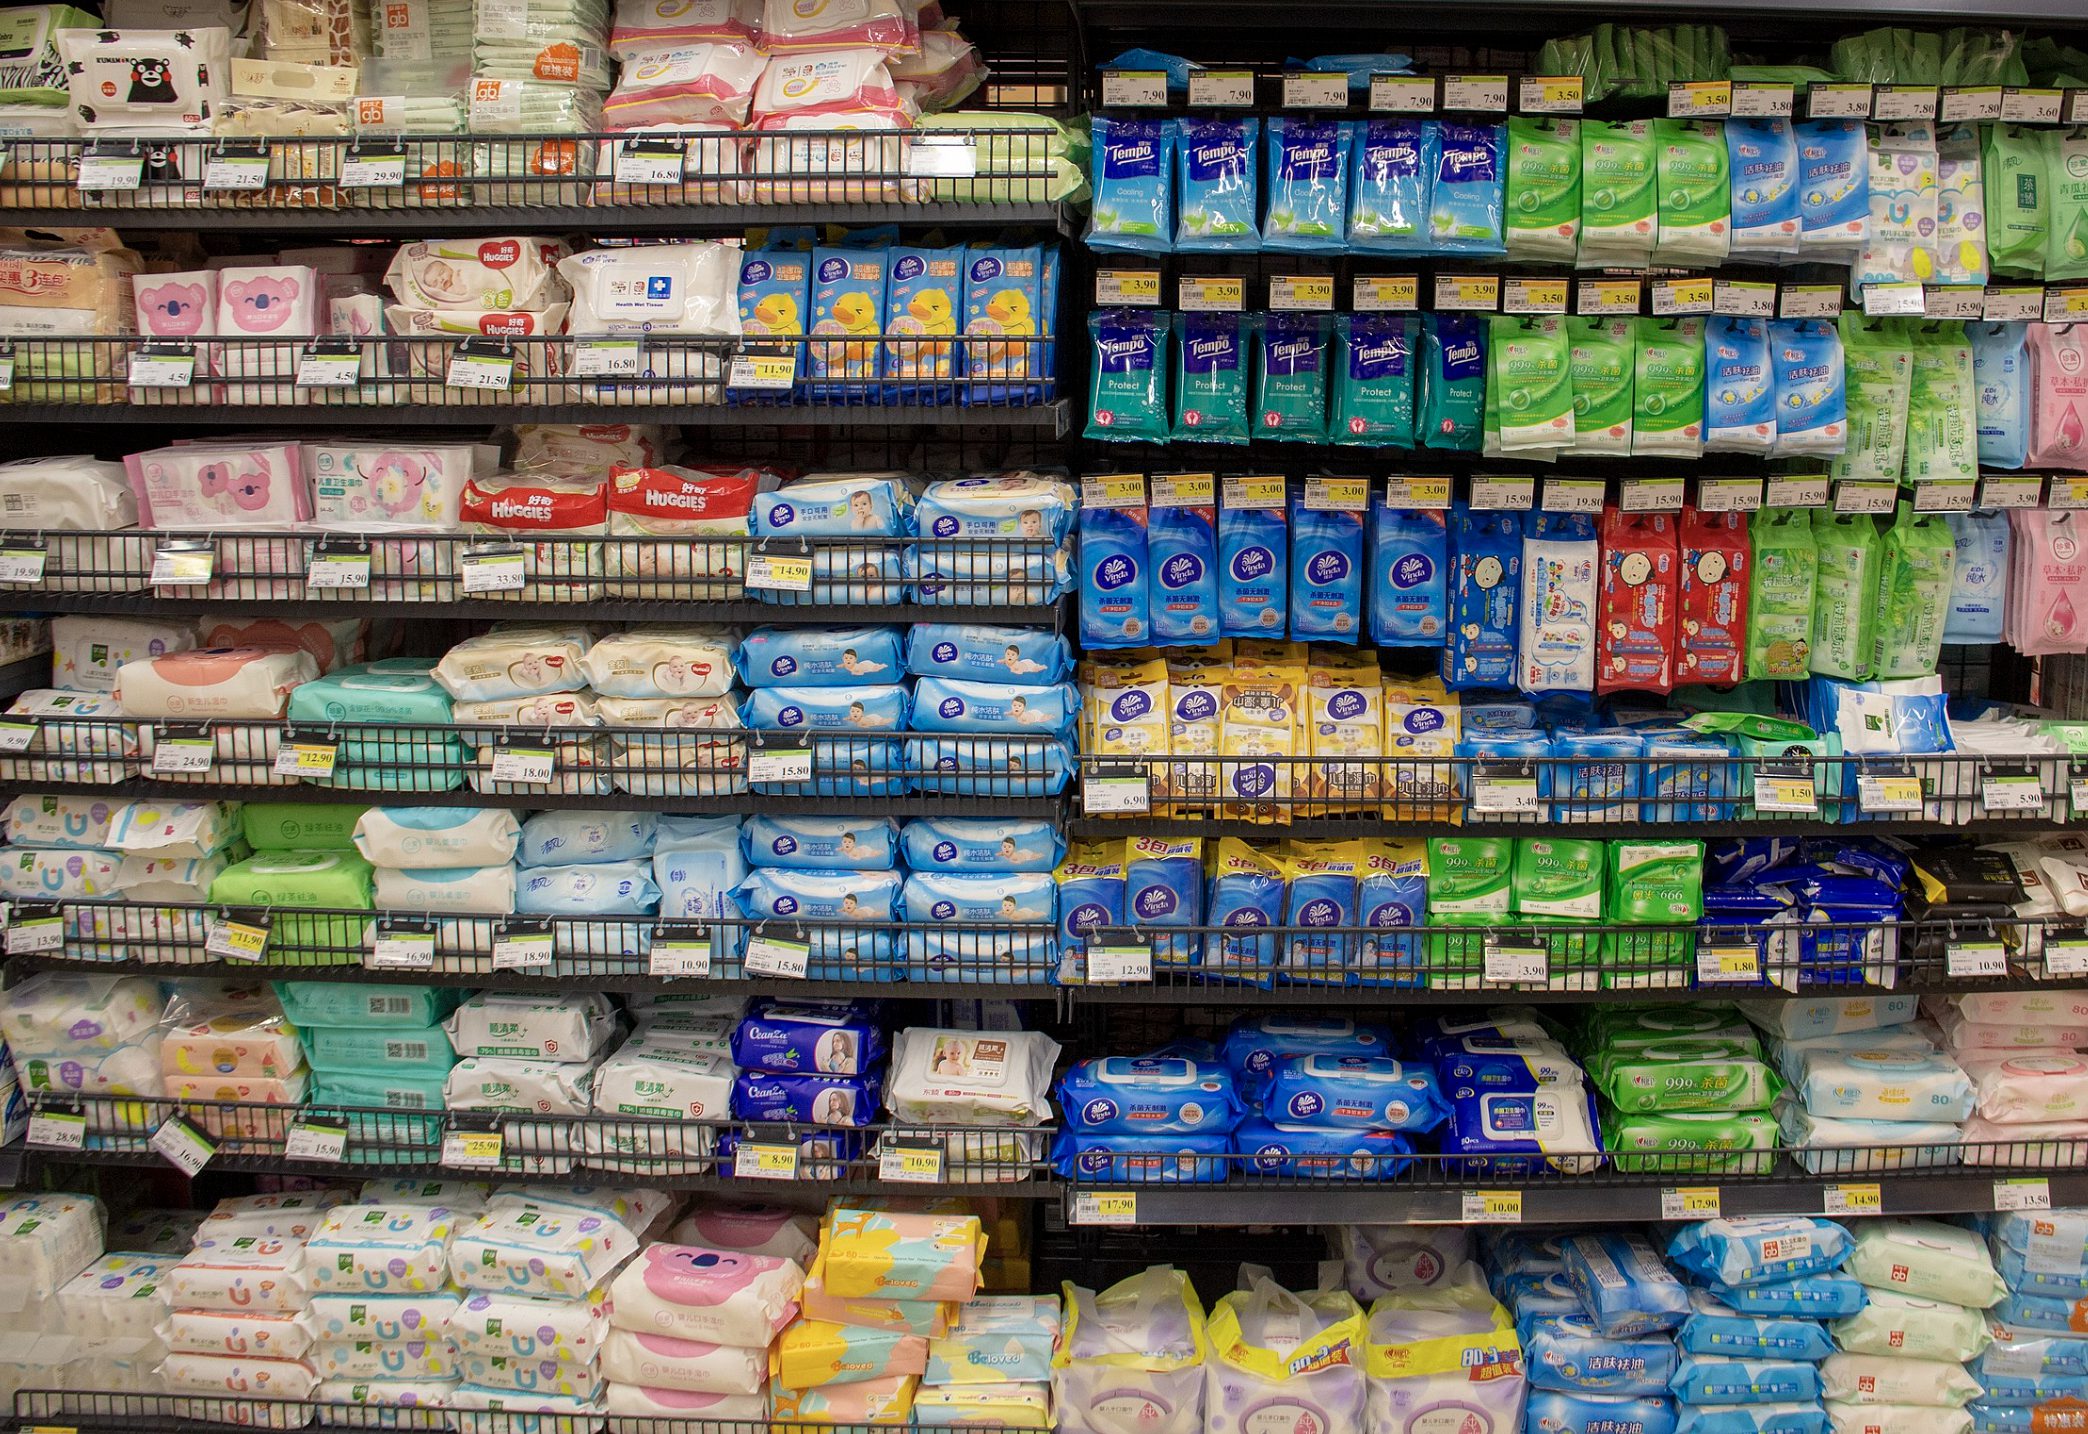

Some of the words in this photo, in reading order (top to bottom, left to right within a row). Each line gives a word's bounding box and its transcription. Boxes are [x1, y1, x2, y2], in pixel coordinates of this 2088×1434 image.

[388, 11, 408, 27] gb
[478, 86, 498, 101] gb
[1143, 90, 1165, 100] 7.90
[1230, 90, 1251, 100] 7.90
[1324, 91, 1345, 101] 7.90
[1557, 91, 1579, 100] 3.50
[1411, 97, 1432, 106] 7.90
[1484, 94, 1505, 104] 7.90
[1705, 95, 1727, 105] 3.50
[1770, 102, 1792, 111] 3.80
[1846, 103, 1868, 112] 3.80
[1914, 104, 1934, 113] 7.80
[1980, 104, 1999, 113] 7.80
[362, 109, 381, 123] gb
[2036, 107, 2058, 117] 3.60
[1110, 145, 1152, 161] Tempo
[1193, 146, 1236, 160] Tempo
[1287, 146, 1330, 161] Tempo
[1370, 147, 1411, 161] Tempo
[1447, 150, 1487, 164] Tempo
[235, 174, 264, 185] 21.50
[374, 171, 402, 181] 29.90
[651, 170, 679, 179] 16.80
[111, 176, 138, 186] 19.90
[1117, 187, 1144, 198] Cooling
[1453, 191, 1480, 201] Cooling
[483, 252, 514, 262] HUGGIES
[746, 270, 767, 280] Vinda
[823, 269, 843, 278] Vinda
[1134, 280, 1156, 289] 3.90
[1217, 286, 1239, 296] 3.90
[1307, 285, 1329, 295] 3.90
[1391, 286, 1413, 295] 3.90
[1473, 286, 1495, 295] 3.90
[1541, 294, 1563, 303] 3.50
[1614, 294, 1636, 304] 3.50
[1688, 292, 1710, 302] 3.50
[1752, 301, 1774, 311] 3.80
[1818, 302, 1840, 312] 3.80
[1955, 302, 1981, 312] 15.90
[2020, 305, 2040, 315] 3.90
[508, 318, 525, 326] 好奇
[486, 325, 525, 336] HUGGIES
[1105, 339, 1144, 354] Tempo
[1193, 339, 1230, 354] Tempo
[1270, 341, 1310, 355] Tempo
[1354, 345, 1398, 361] Tempo
[1446, 346, 1478, 360] Tempo
[608, 359, 635, 369] 16.80
[764, 365, 791, 374] 11.90
[168, 373, 189, 382] 4.50
[335, 372, 356, 381] 4.50
[479, 375, 507, 386] 21.50
[1109, 380, 1139, 390] Protect
[1195, 381, 1225, 390] Protect
[1276, 382, 1306, 392] Protect
[1361, 387, 1392, 397] Protect
[1449, 388, 1472, 398] Protect
[1119, 482, 1142, 492] 3.00
[1188, 482, 1211, 491] 3.00
[1260, 484, 1283, 494] 3.00
[1342, 486, 1365, 496] 3.00
[1424, 485, 1446, 495] 3.00
[528, 495, 553, 505] 好奇
[646, 490, 706, 508] HUGGIES
[1505, 494, 1532, 504] 15.90
[1655, 494, 1682, 505] 15.90
[1733, 496, 1759, 505] 15.90
[1799, 491, 1826, 501] 15.90
[1946, 496, 1972, 505] 15.90
[2017, 494, 2037, 503] 3.90
[1576, 497, 1603, 507] 19.80
[1867, 499, 1892, 508] 15.90
[491, 501, 552, 520] HUGGIES
[966, 521, 996, 529] 手口可用
[14, 567, 40, 577] 19.90
[780, 566, 808, 577] 14.90
[1241, 562, 1266, 572] Vinda
[1317, 566, 1342, 577] Vinda
[340, 574, 367, 584] 15.90
[497, 573, 524, 584] 33.80
[1103, 571, 1129, 582] Vinda
[1168, 570, 1194, 581] Vinda
[1400, 569, 1427, 579] Vinda
[1124, 701, 1149, 712] Vinda
[1185, 702, 1210, 713] Vinda
[1337, 702, 1360, 713] Vinda
[1412, 718, 1438, 728] Vinda
[183, 756, 209, 767] 24.90
[305, 752, 332, 763] 12.90
[523, 767, 549, 778] 18.00
[781, 766, 809, 776] 15.80
[1240, 770, 1266, 781] Vinda
[1791, 788, 1811, 798] 1.50
[1899, 790, 1918, 799] 1.00
[1123, 795, 1146, 806] 6.90
[1516, 797, 1537, 807] 3.40
[2020, 794, 2040, 803] 5.90
[1136, 836, 1169, 855] 3包
[1227, 855, 1256, 870] 3包
[1368, 855, 1397, 871] 3包
[1063, 863, 1096, 876] 3包
[1144, 901, 1169, 911] Vinda
[1308, 914, 1333, 925] Vinda
[36, 935, 62, 948] 13.90
[236, 933, 263, 947] 11.90
[405, 952, 432, 961] 16.90
[523, 951, 550, 961] 18.90
[681, 960, 708, 970] 10.90
[776, 961, 804, 972] 15.80
[1121, 965, 1149, 975] 12.90
[1734, 961, 1754, 972] 1.80
[1979, 961, 2004, 970] 10.90
[1523, 966, 1544, 976] 3.90
[1888, 1001, 1904, 1011] 80
[1702, 1077, 1728, 1089] 杀菌
[1931, 1095, 1949, 1105] 80
[1297, 1103, 1317, 1112] Vinda
[1090, 1110, 1111, 1119] Vinda
[56, 1132, 81, 1144] 28.90
[315, 1143, 340, 1155] 15.90
[472, 1141, 498, 1151] 25.90
[178, 1147, 203, 1170] 16.90
[771, 1154, 793, 1165] 8.90
[910, 1157, 937, 1168] 10.90
[1691, 1199, 1717, 1209] 17.90
[1853, 1194, 1879, 1205] 14.90
[2023, 1193, 2048, 1205] 13.50
[1106, 1199, 1133, 1210] 17.90
[1492, 1202, 1519, 1212] 10.00
[875, 1276, 918, 1287] Beloved
[968, 1351, 1022, 1364] Beloved
[831, 1360, 873, 1371] Beloved
[1587, 1356, 1645, 1370] 洁肤祛油
